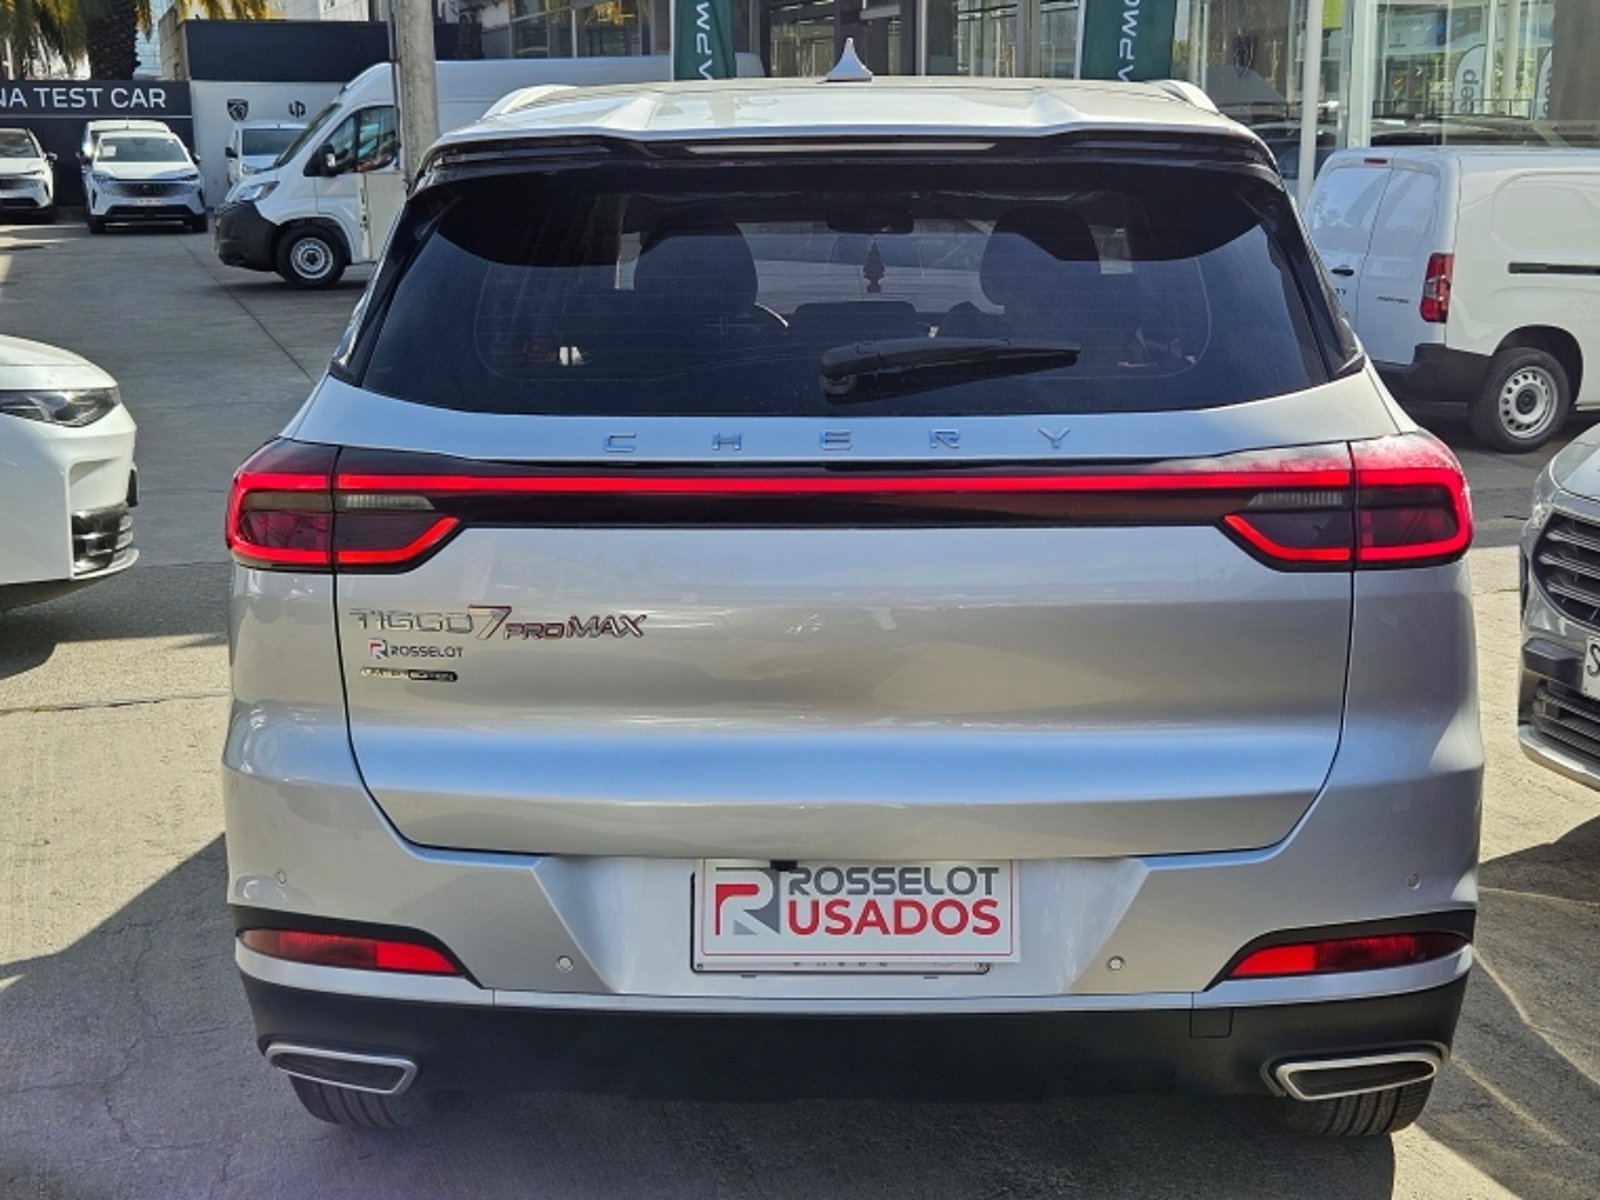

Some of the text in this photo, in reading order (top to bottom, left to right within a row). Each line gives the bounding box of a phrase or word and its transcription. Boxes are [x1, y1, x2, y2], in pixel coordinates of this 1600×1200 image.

[33, 87, 104, 109] TEST
[110, 87, 167, 109] CAR
[603, 426, 1071, 453] CHERY
[349, 607, 473, 634] TIGGO
[503, 622, 565, 640] PRO
[566, 613, 648, 638] MAX
[390, 645, 464, 659] ROSSELOT
[788, 866, 999, 896] ROSSELOT
[788, 898, 1002, 936] USADOS
